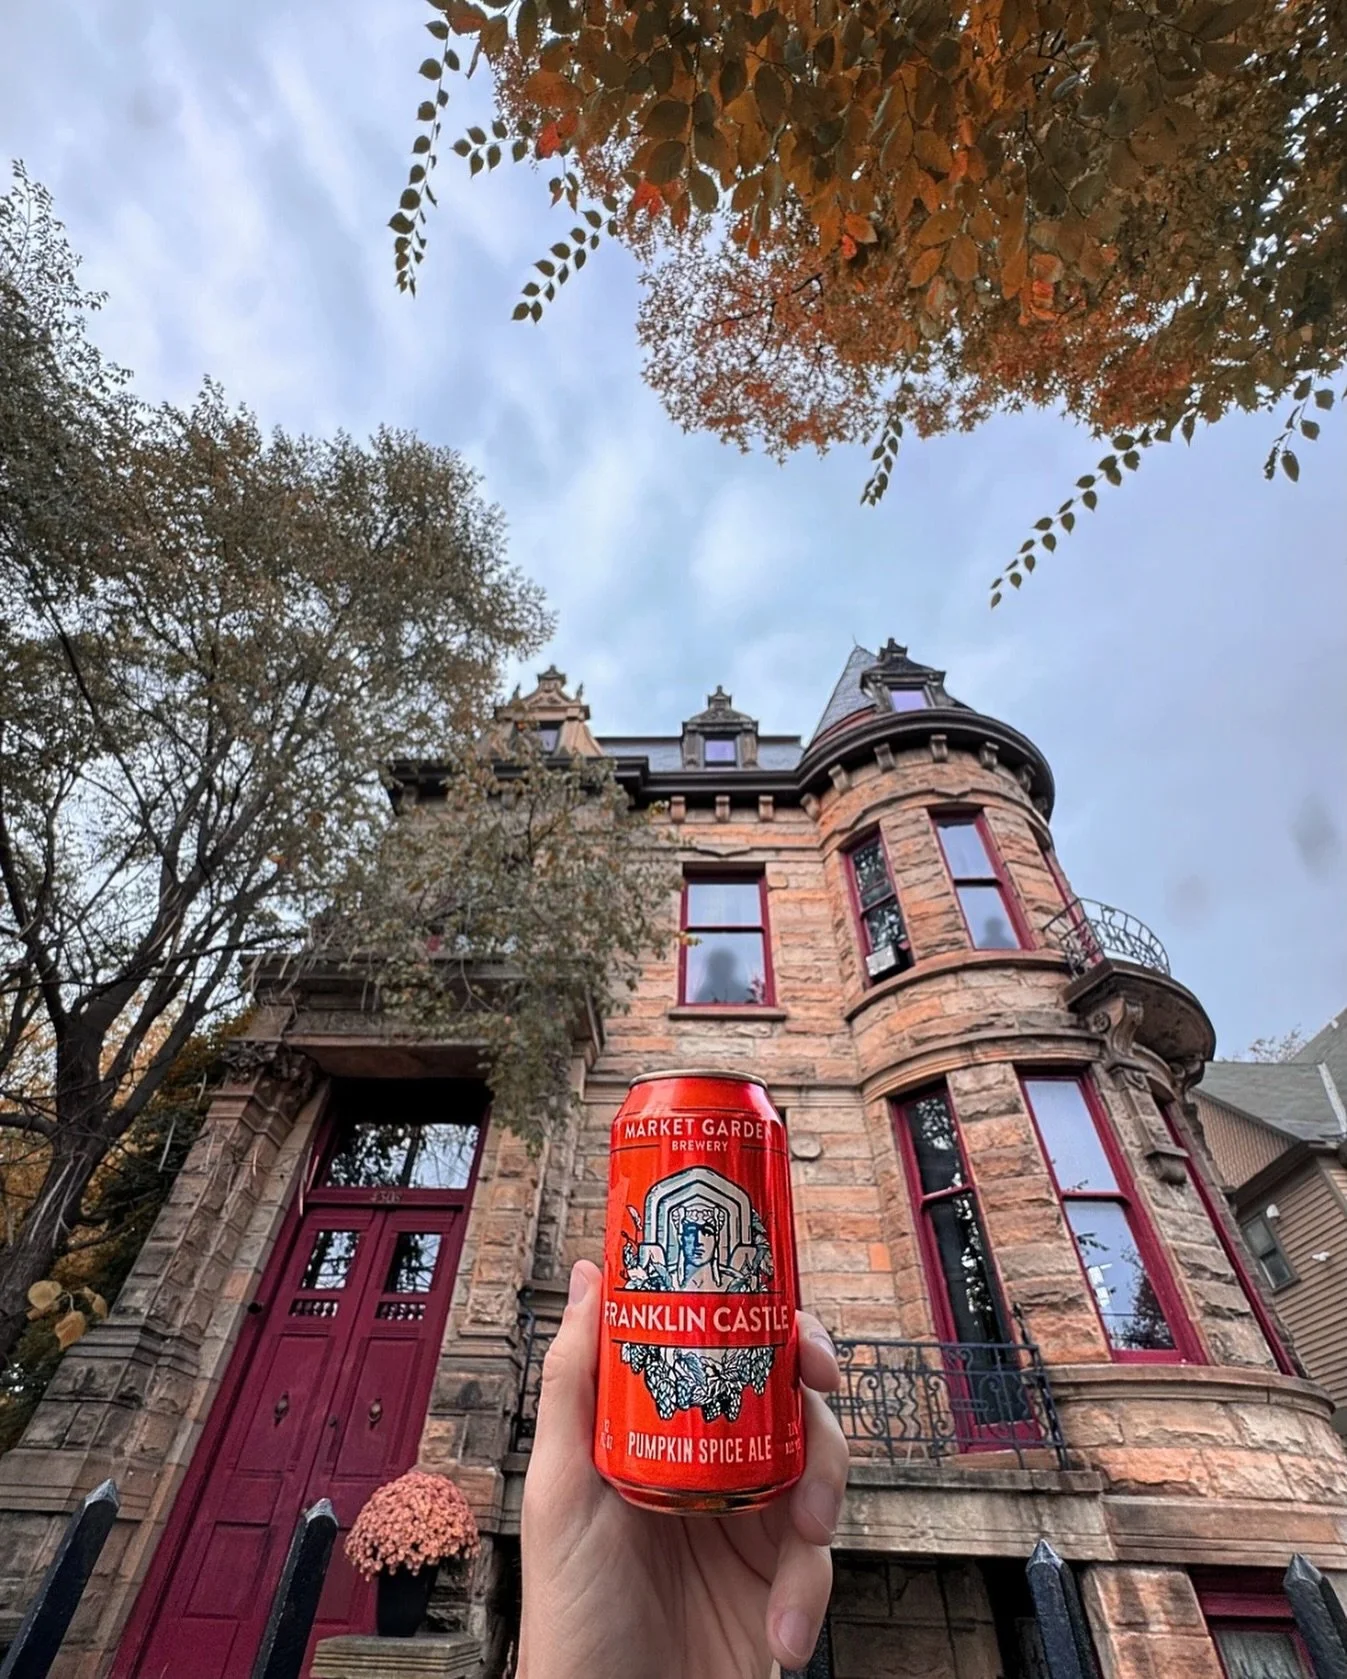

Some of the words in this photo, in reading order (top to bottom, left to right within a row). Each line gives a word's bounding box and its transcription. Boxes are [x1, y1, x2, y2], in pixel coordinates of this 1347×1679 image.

[624, 1118, 695, 1139] MARKET
[672, 1140, 728, 1152] BREWERY
[604, 1301, 706, 1332] FRANKLIN
[713, 1305, 789, 1333] CASTLE
[627, 1431, 693, 1462] PUMPKIN
[699, 1438, 743, 1464] SPICE
[748, 1435, 772, 1462] ALE
